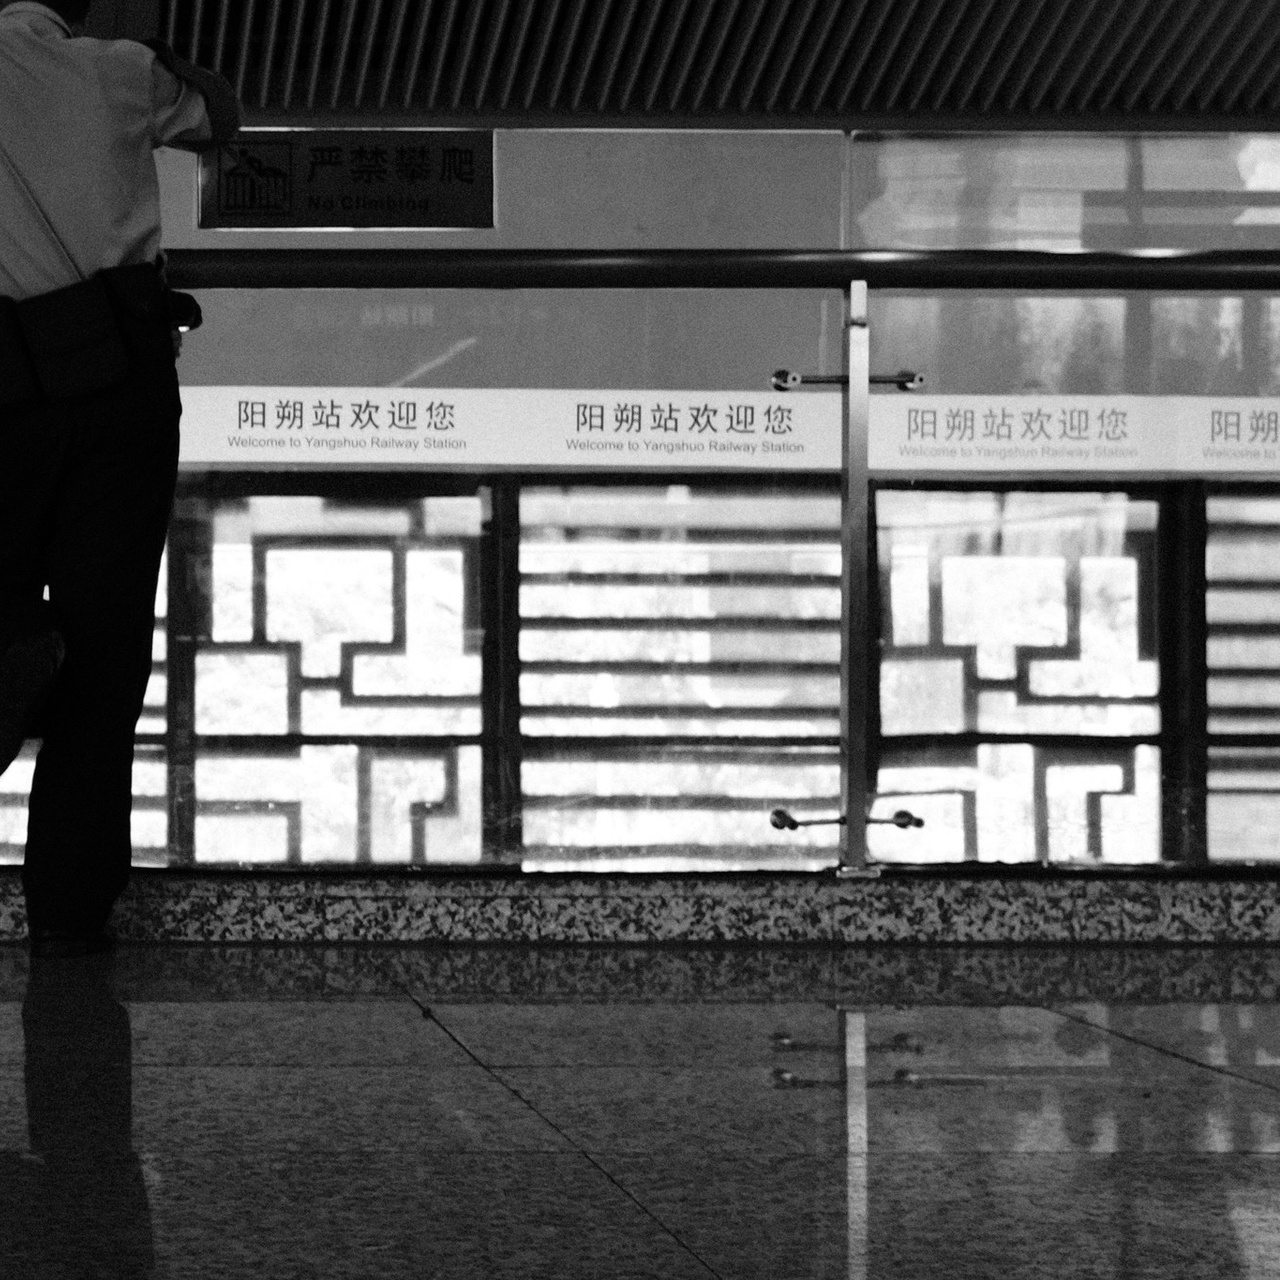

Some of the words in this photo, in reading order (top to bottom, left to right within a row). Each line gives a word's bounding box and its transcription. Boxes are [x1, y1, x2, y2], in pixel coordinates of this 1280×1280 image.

[308, 146, 474, 184] 严禁攀爬
[309, 197, 334, 211] No
[341, 196, 430, 212] Climbing
[237, 400, 456, 430] 阳朔站欢迎您
[576, 403, 793, 434] 阳朔站欢迎您
[908, 407, 1128, 441] 阳朔站欢迎您
[227, 436, 286, 448] Welcome
[289, 437, 301, 448] to
[305, 437, 367, 450] Yangshuo
[371, 437, 419, 451] Railway
[423, 438, 467, 450] Station
[565, 439, 624, 451] Welcome
[628, 440, 639, 451] to
[643, 440, 705, 454] Yangshuo
[709, 441, 757, 454] Railway
[761, 441, 804, 453] Station
